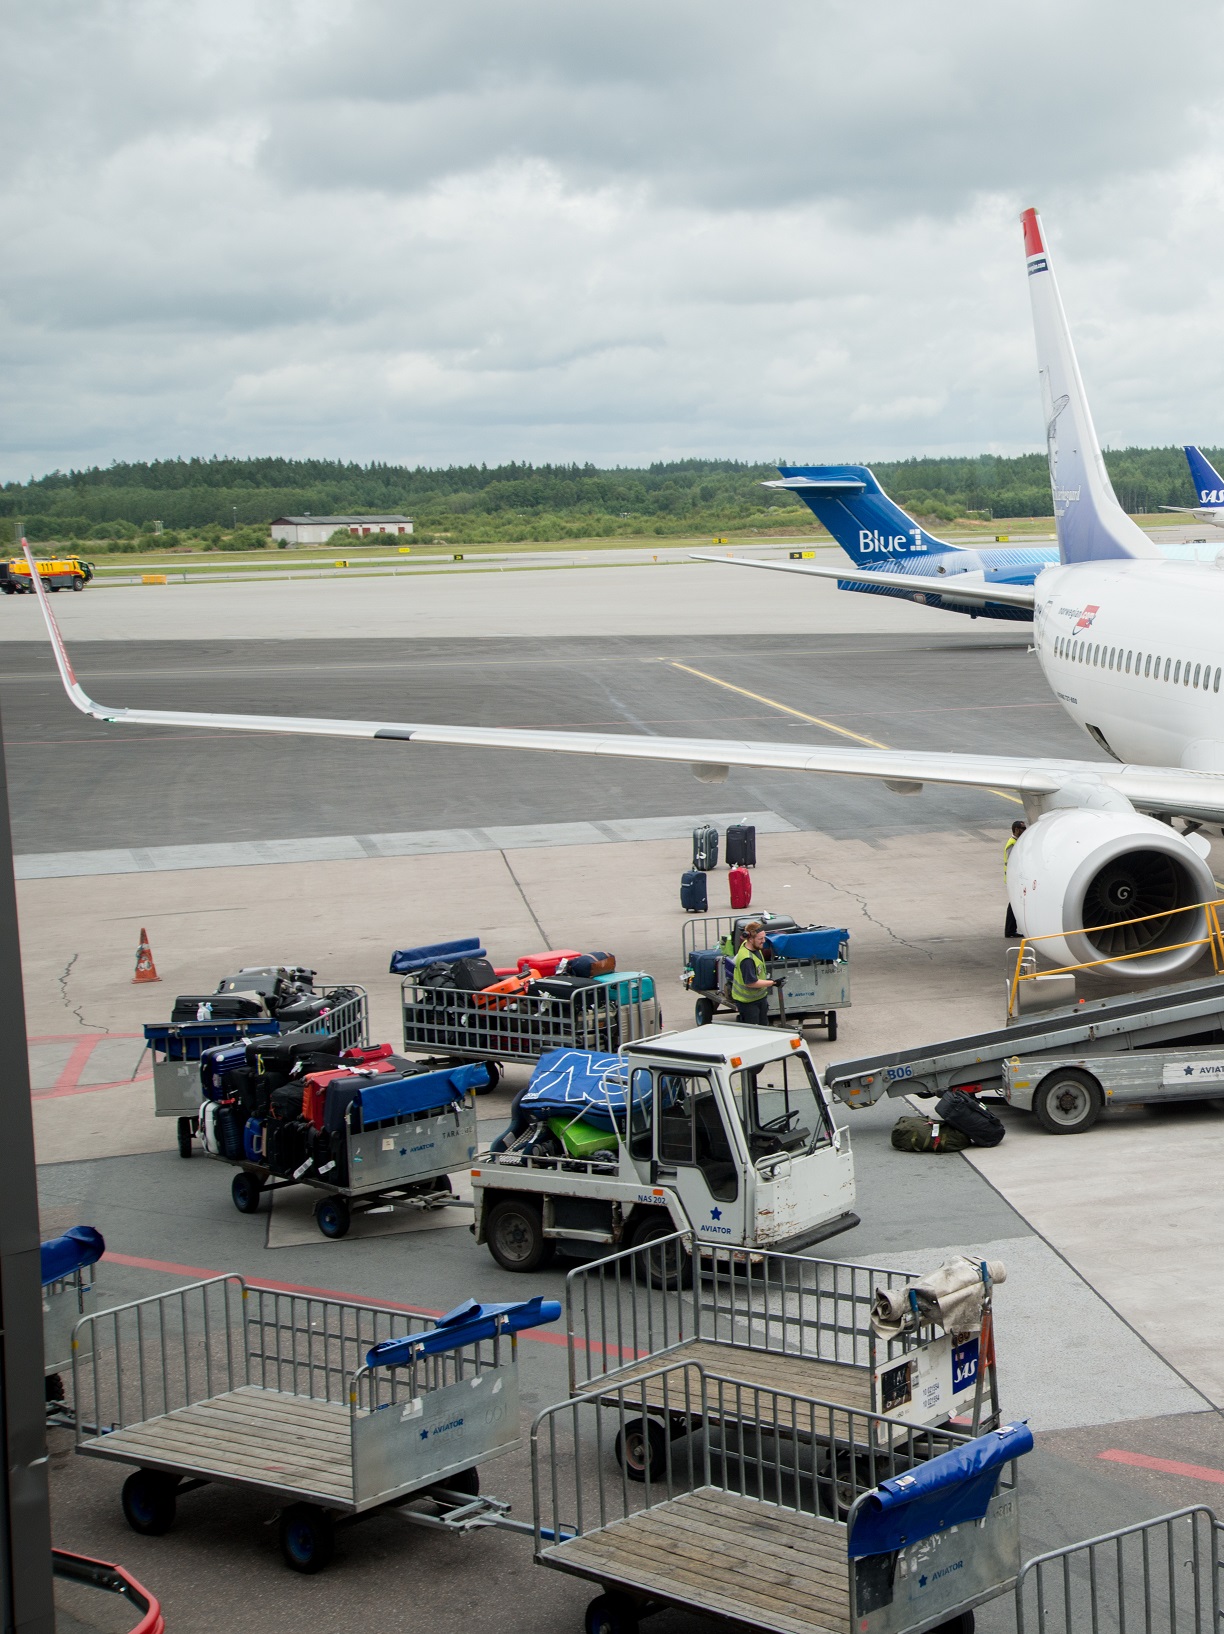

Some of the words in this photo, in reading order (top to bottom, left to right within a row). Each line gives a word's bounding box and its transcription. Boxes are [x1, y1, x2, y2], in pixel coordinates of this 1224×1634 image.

[41, 563, 54, 572] 111
[887, 1065, 912, 1080] B06
[442, 1130, 460, 1140] TARA
[410, 1142, 435, 1153] AVIATOR
[638, 1194, 652, 1203] NAS
[653, 1196, 666, 1205] 202
[700, 1224, 732, 1235] AVIATOR
[953, 1358, 978, 1384] SAS
[432, 1418, 465, 1436] AVIATOR
[931, 1560, 964, 1582] AVIATOR
